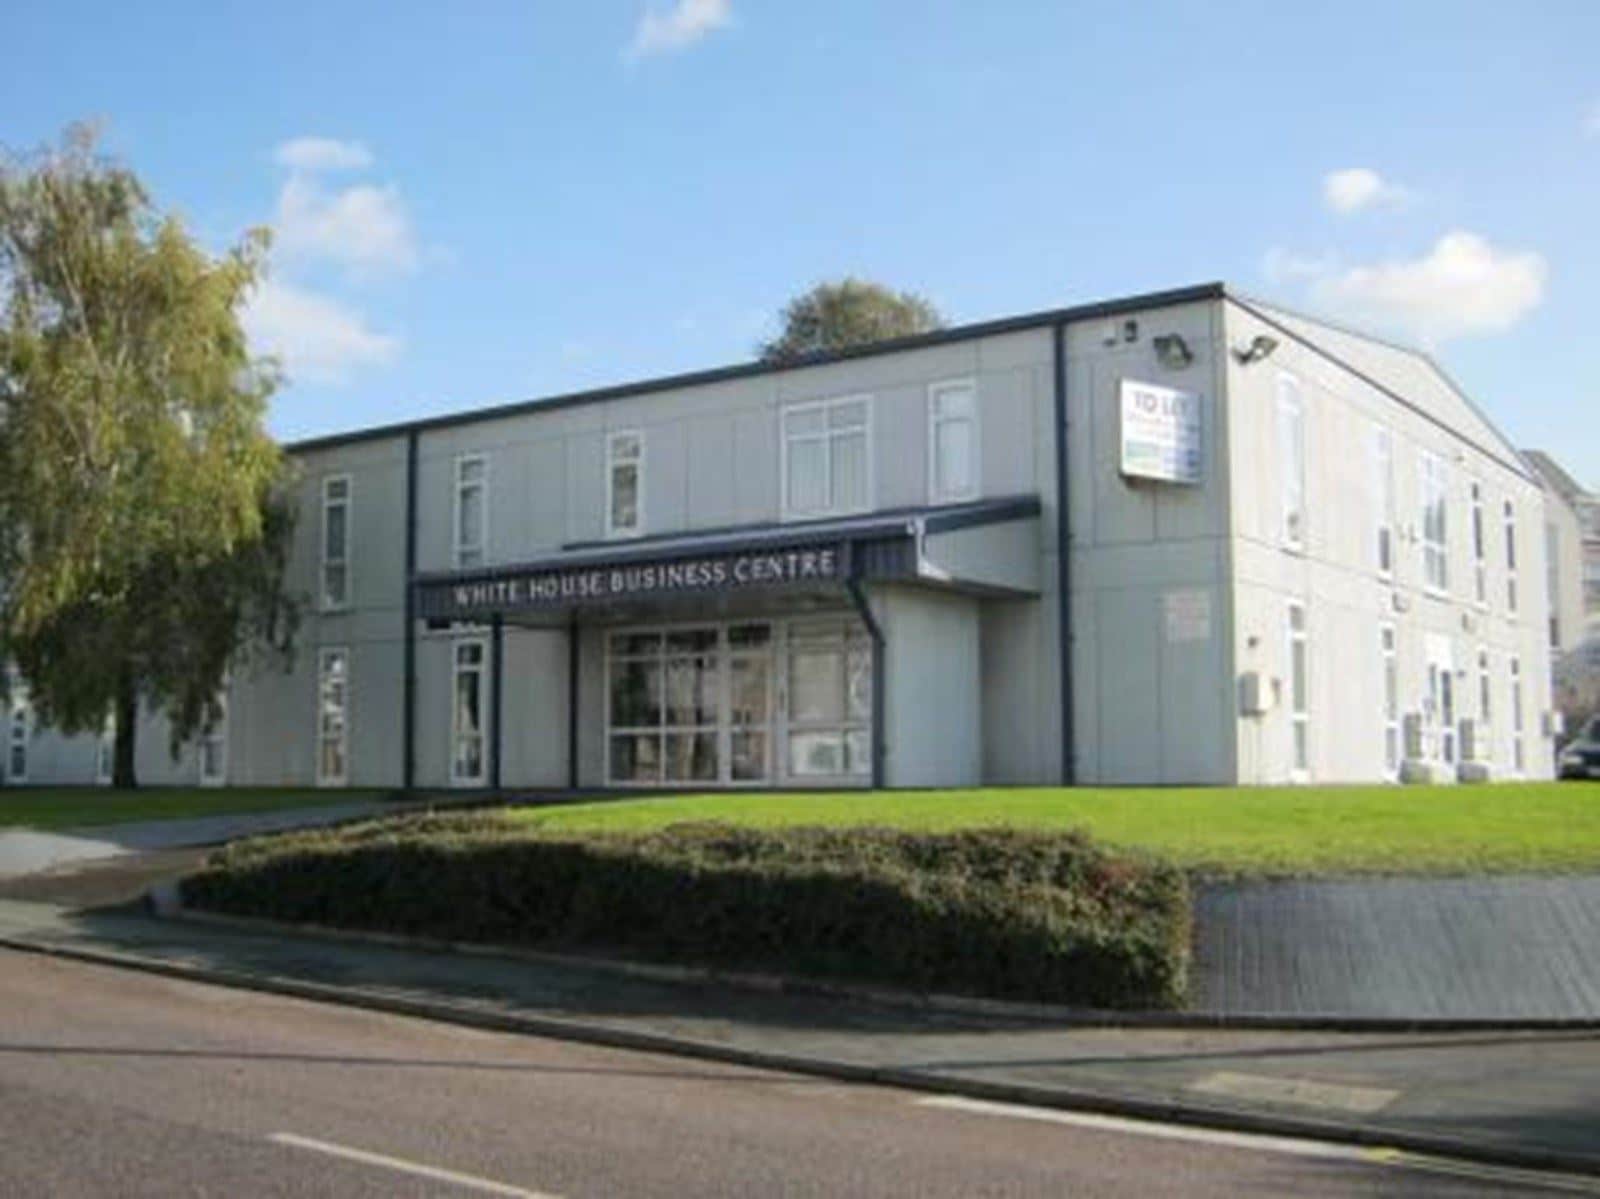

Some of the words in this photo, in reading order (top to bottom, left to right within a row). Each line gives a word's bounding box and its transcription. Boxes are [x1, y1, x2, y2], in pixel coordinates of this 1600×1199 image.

[453, 583, 519, 607] WHITE
[530, 573, 602, 601] HOUSE
[611, 562, 725, 592] BUSINESS
[734, 550, 834, 582] CENTRE
